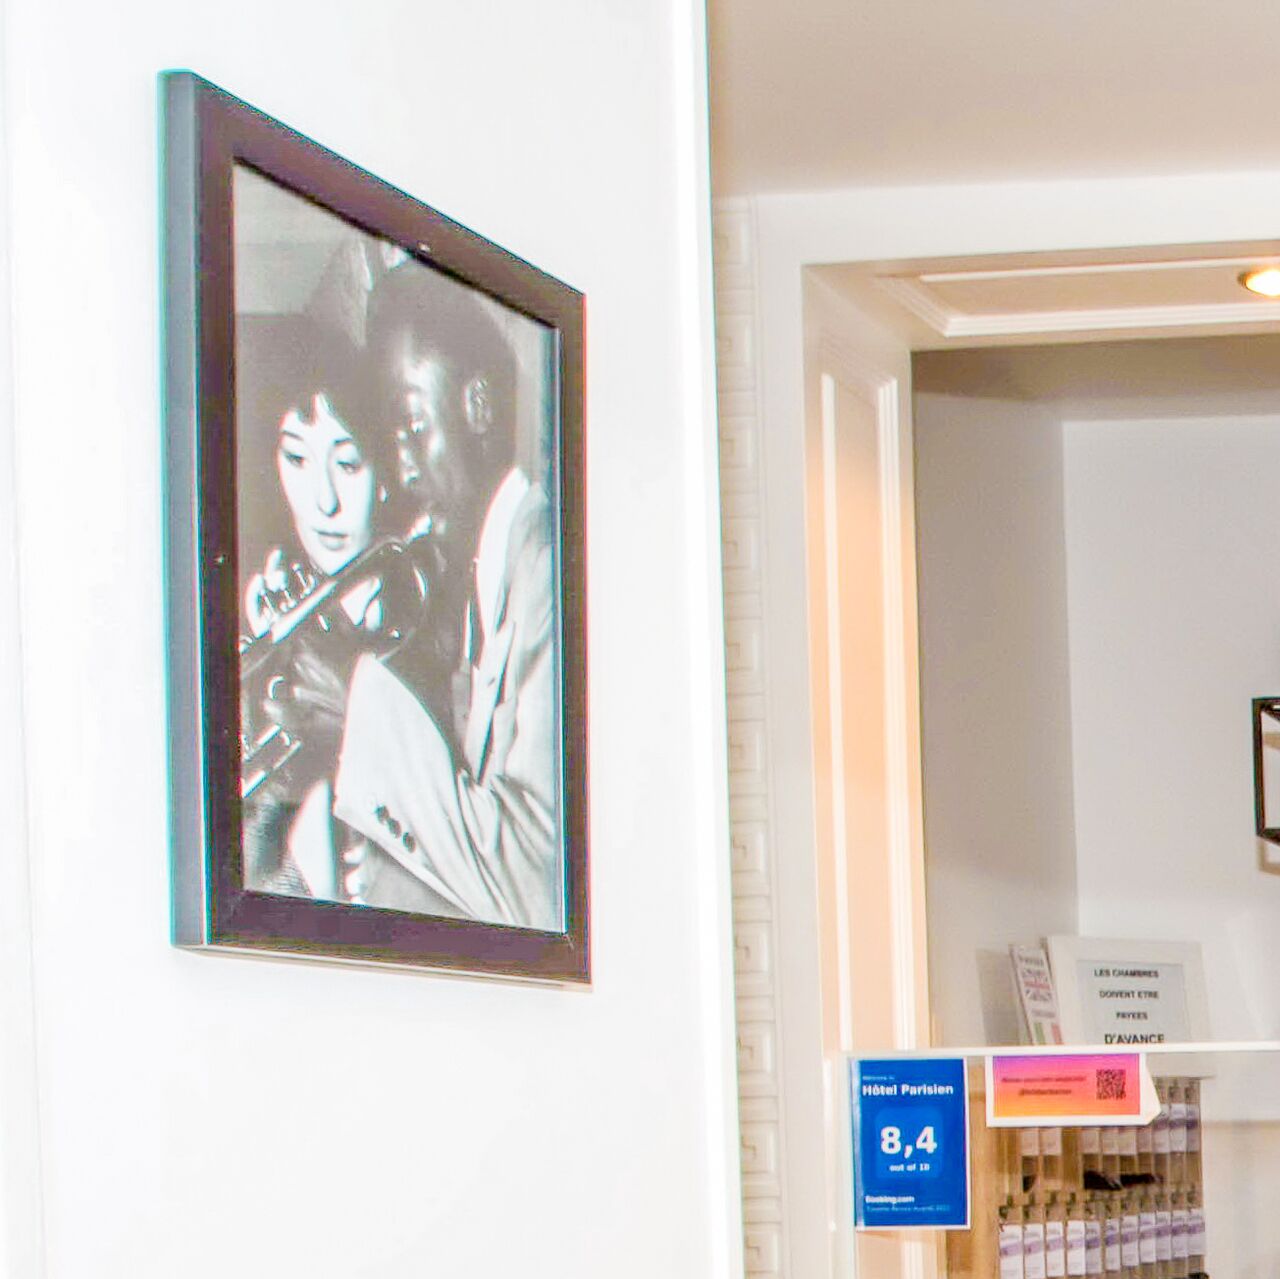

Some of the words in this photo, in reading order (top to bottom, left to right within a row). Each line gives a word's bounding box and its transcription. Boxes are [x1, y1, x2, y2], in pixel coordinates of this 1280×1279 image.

[1094, 968, 1111, 978] LES
[1112, 969, 1159, 979] CHAMBRES
[1099, 990, 1135, 999] DOIVENT
[1104, 1033, 1165, 1044] D'AVANCE
[862, 1082, 898, 1096] Hôtel
[901, 1083, 955, 1096] Parisien
[880, 1126, 938, 1160] 8,4
[889, 1163, 905, 1172] out
